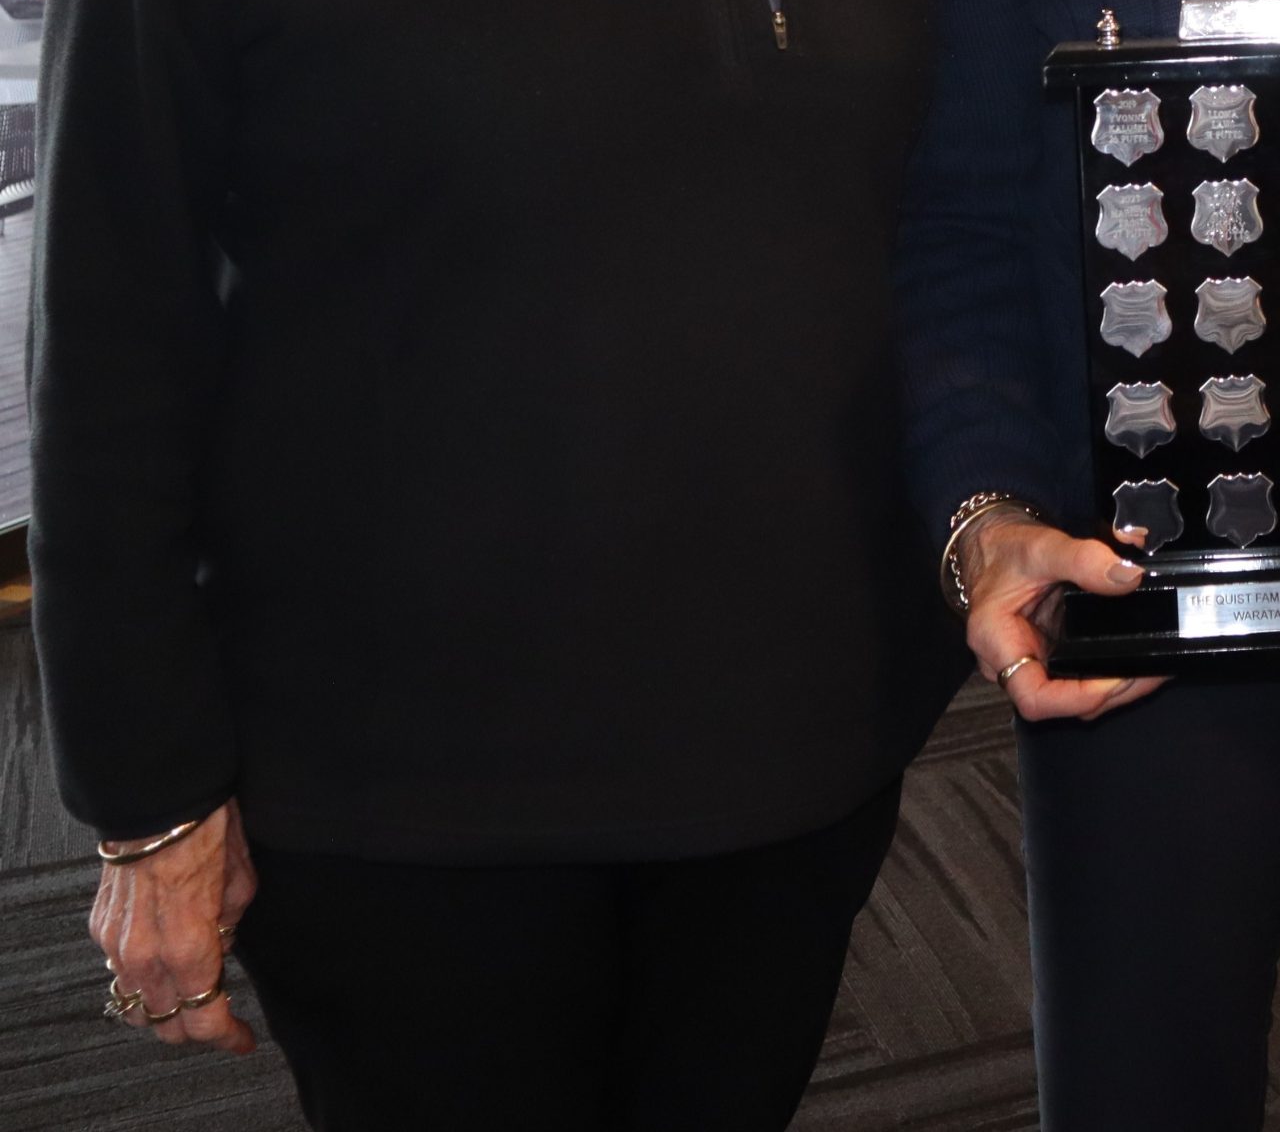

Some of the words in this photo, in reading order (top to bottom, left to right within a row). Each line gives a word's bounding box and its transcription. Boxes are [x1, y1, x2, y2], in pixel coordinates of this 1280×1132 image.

[1109, 113, 1147, 123] YVONNE
[1121, 134, 1148, 144] PUTTS
[1190, 595, 1212, 606] THE
[1216, 593, 1251, 606] QUIST
